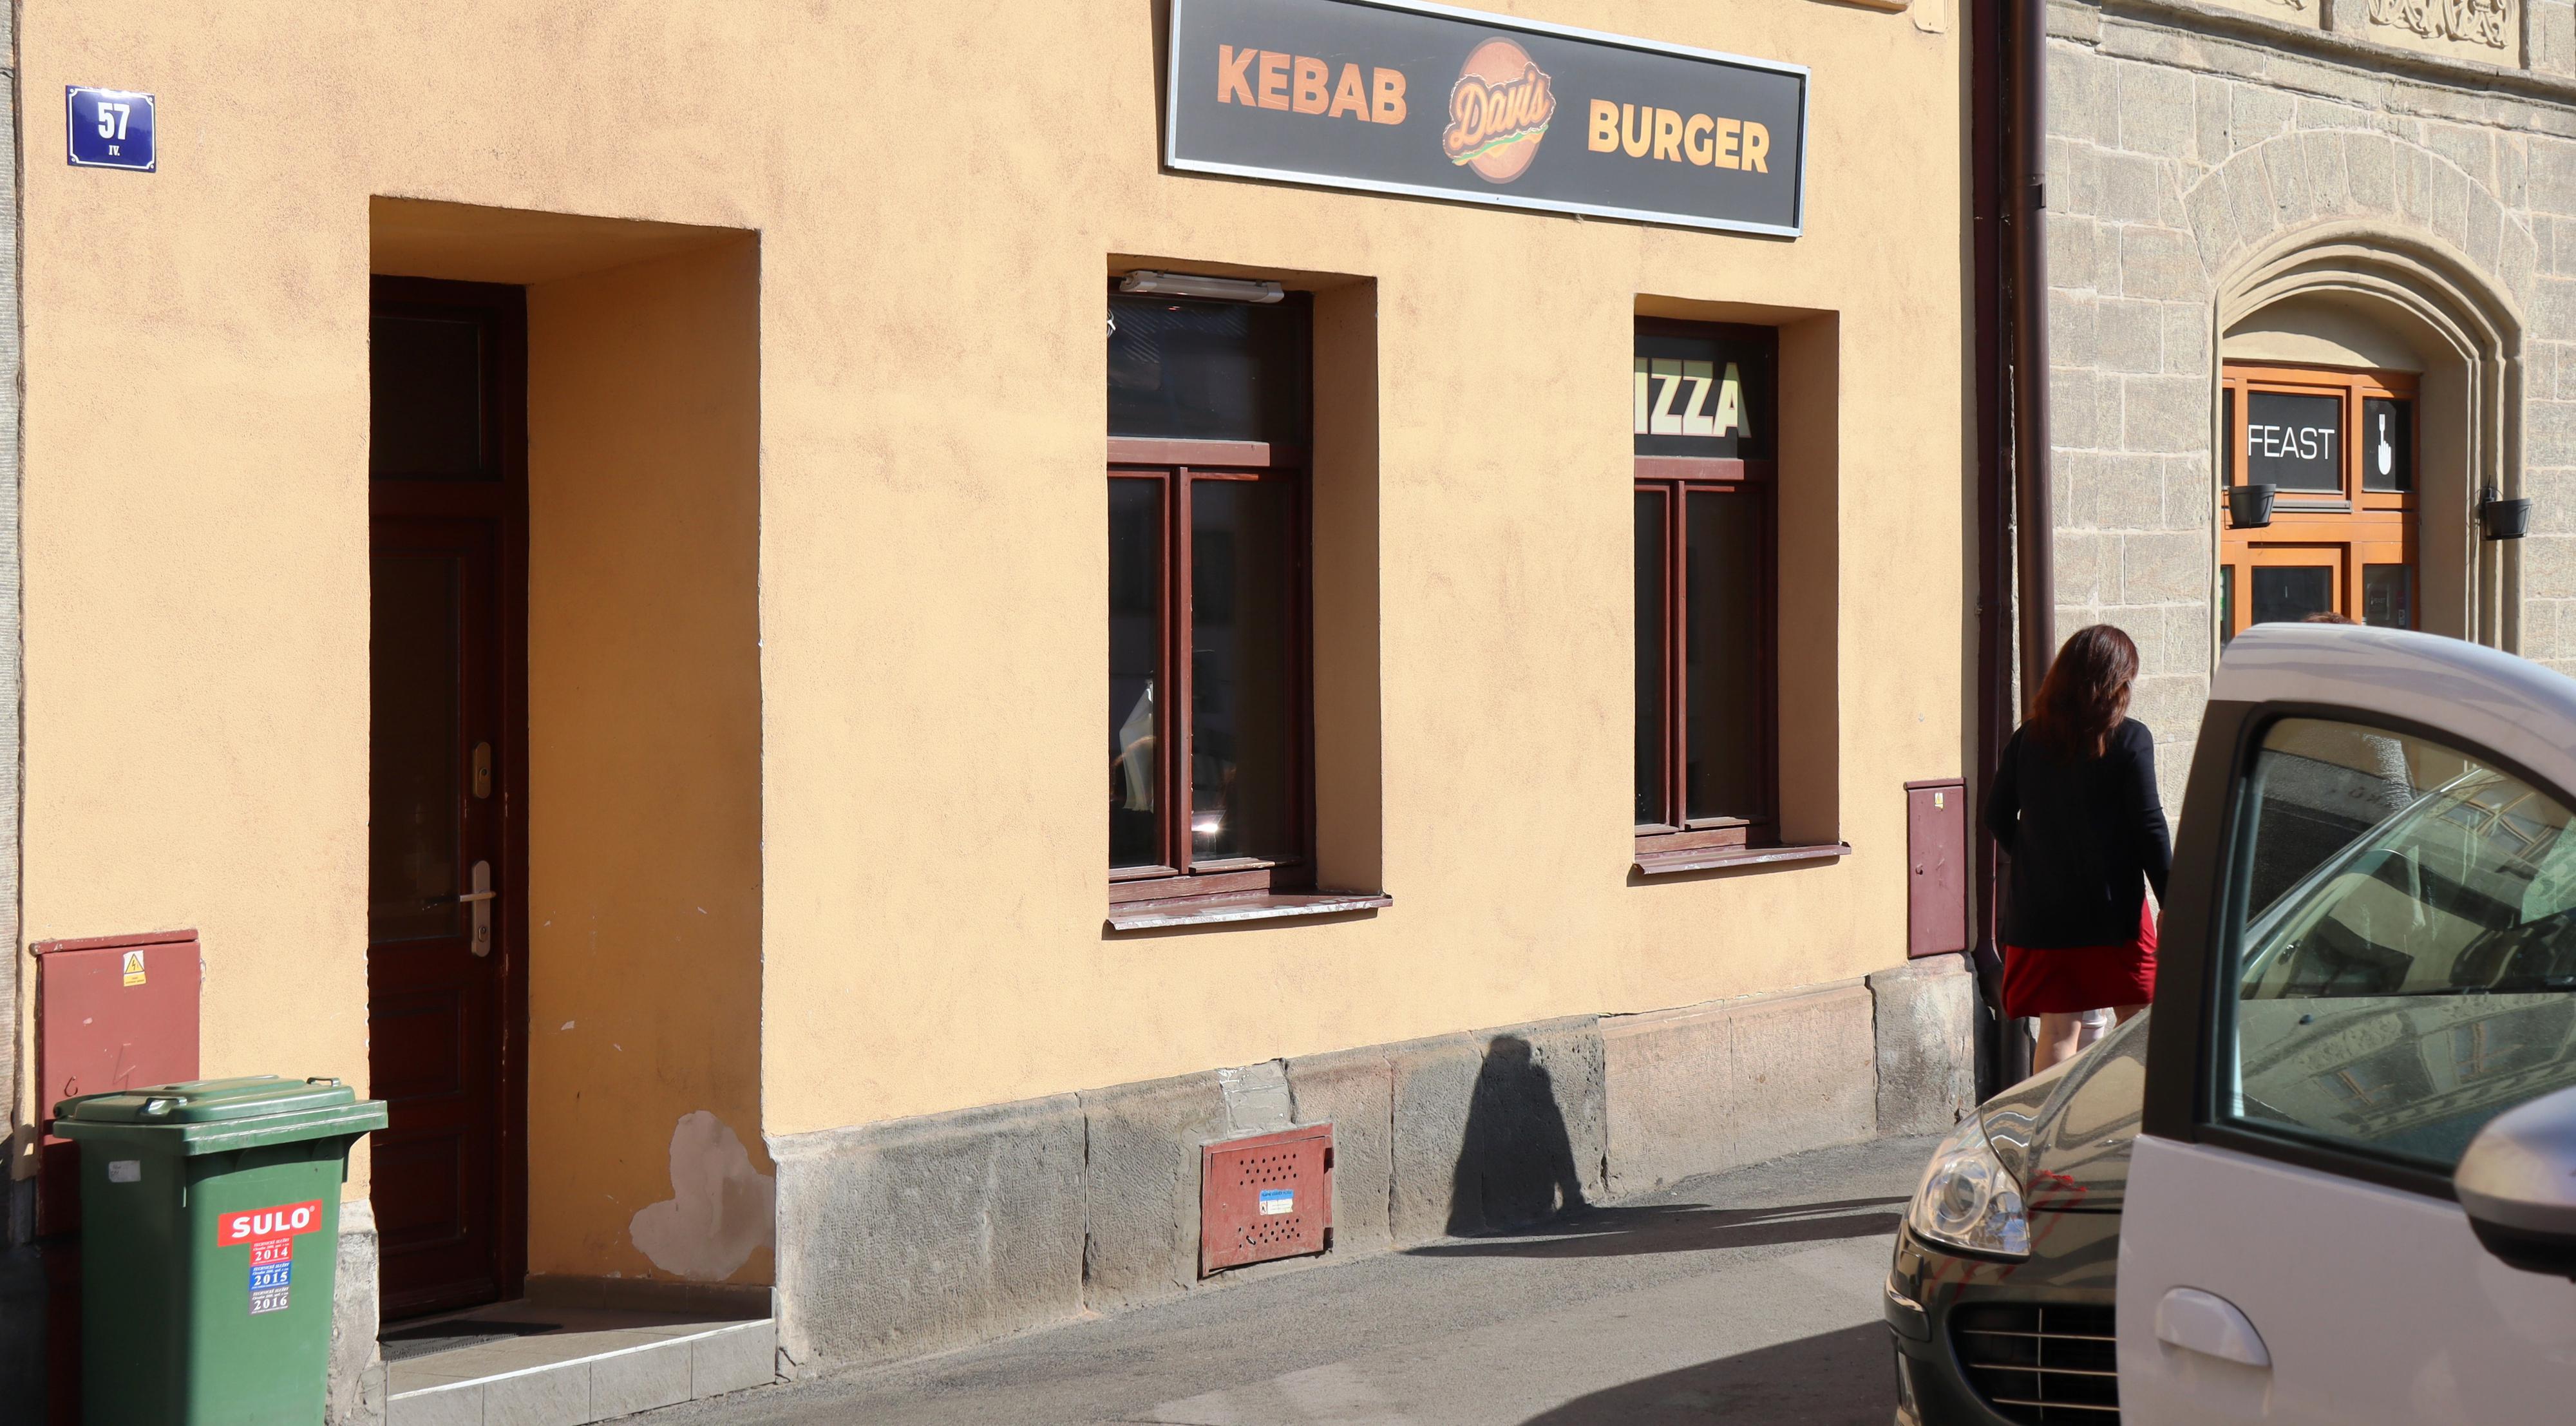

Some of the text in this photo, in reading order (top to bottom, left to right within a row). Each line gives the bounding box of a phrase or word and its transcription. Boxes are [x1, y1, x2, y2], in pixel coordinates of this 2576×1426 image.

[1217, 44, 1408, 126] KEBAB
[97, 102, 130, 140] 57
[1450, 69, 1550, 150] Davis
[1588, 99, 1770, 174] BURGER
[1634, 357, 1752, 438] IZZA
[2248, 424, 2335, 459] FEAST
[255, 1247, 288, 1261] 2014
[254, 1271, 288, 1286] 2015
[254, 1295, 287, 1311] 2016
